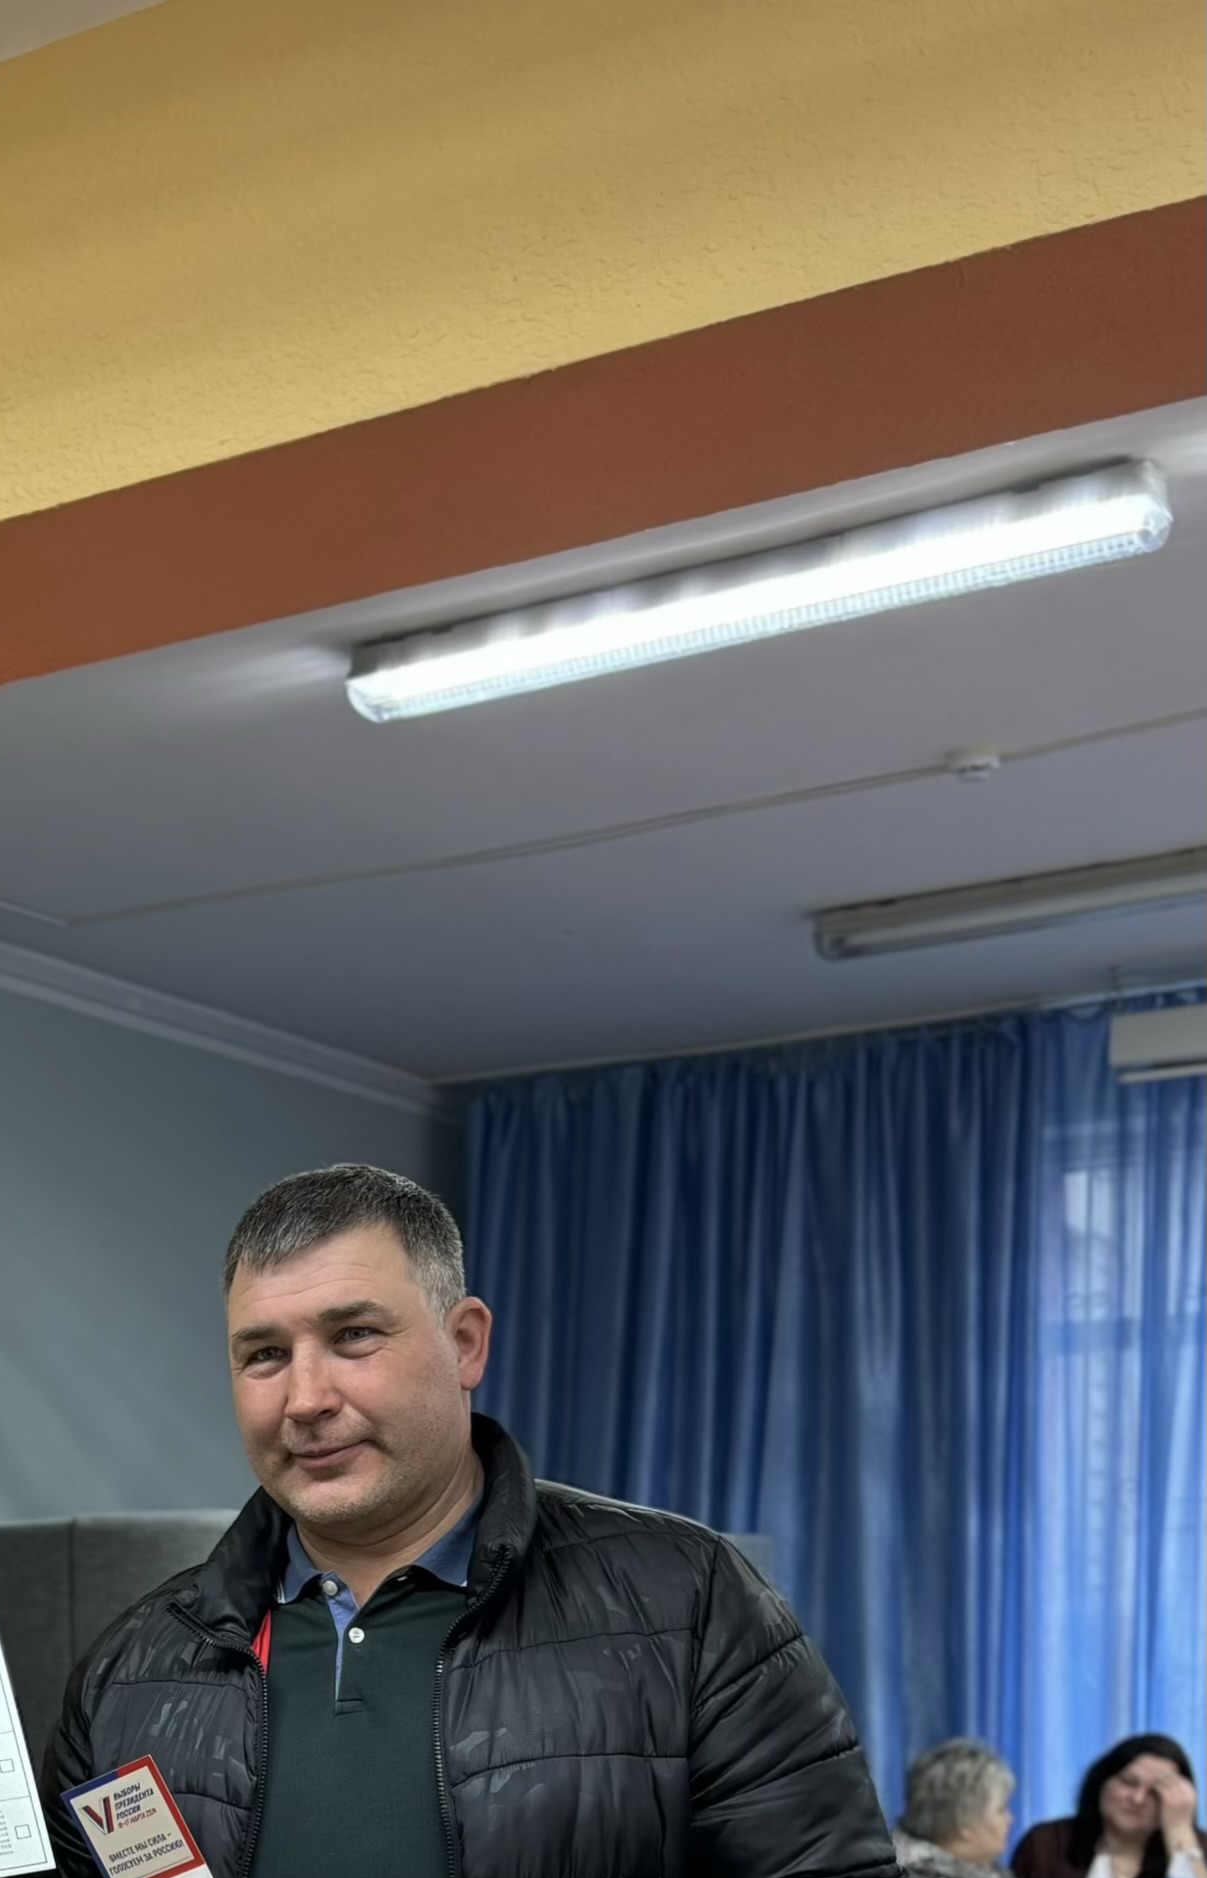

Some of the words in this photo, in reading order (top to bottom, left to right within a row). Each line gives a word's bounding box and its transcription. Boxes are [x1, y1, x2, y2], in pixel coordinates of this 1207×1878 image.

[113, 1782, 141, 1801] ВЫБОРЫ
[114, 1788, 154, 1810] ПРЕЗИДЕНТА
[116, 1804, 141, 1821] РОССИИ
[108, 1846, 134, 1863] ВМЕСТЕ
[135, 1842, 148, 1853] МЫ
[148, 1835, 167, 1849] СИЛА
[109, 1856, 145, 1876] ГОЛОСУЕМ
[144, 1852, 153, 1861] ЗА
[153, 1839, 184, 1856] РОССИЮ!
